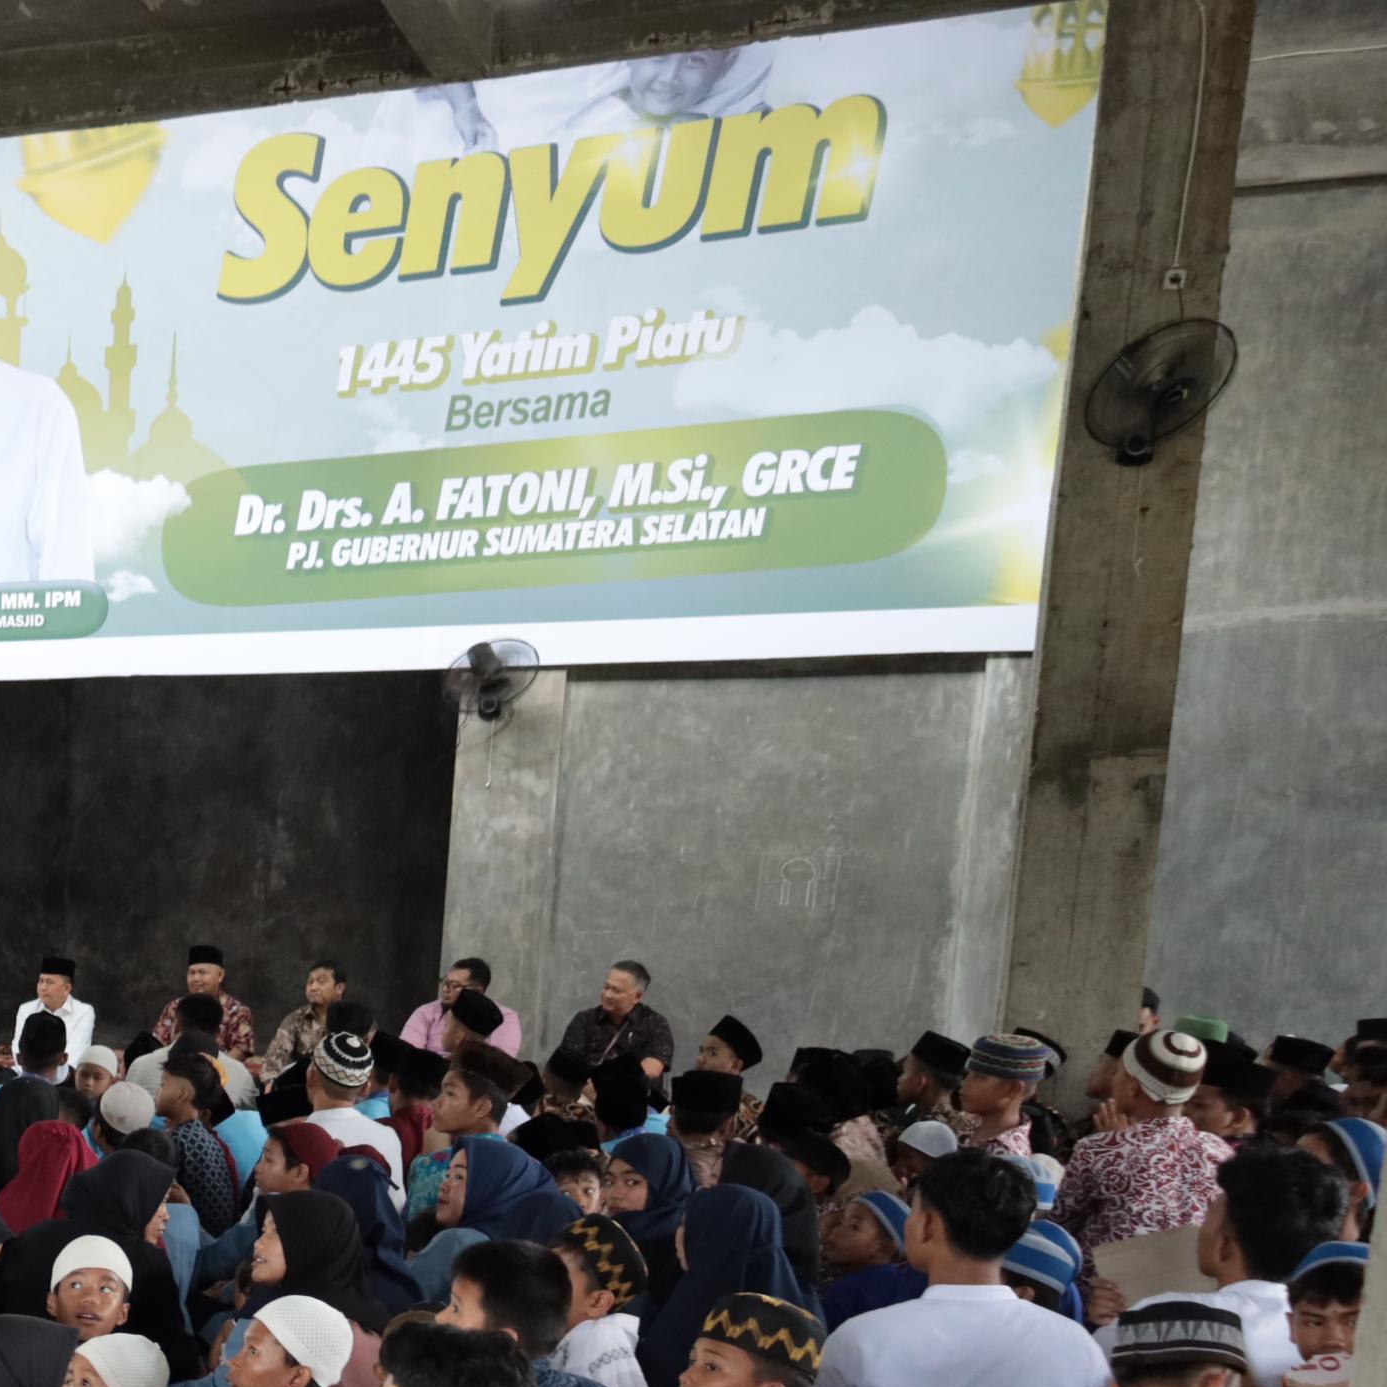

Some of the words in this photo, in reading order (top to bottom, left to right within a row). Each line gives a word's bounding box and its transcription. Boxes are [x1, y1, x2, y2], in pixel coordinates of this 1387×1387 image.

[216, 95, 888, 307] Senyum
[337, 335, 452, 397] 1445
[461, 320, 598, 385] Yatim
[602, 308, 744, 371] Piatu
[444, 388, 611, 432] Bersama
[234, 494, 286, 536] Dr.
[296, 489, 372, 532] Drs.
[380, 482, 425, 526] A.
[435, 467, 597, 521] FATONI,
[608, 453, 728, 510] M.Si.,
[742, 444, 862, 497] GRCE
[286, 540, 324, 570] PJ.
[331, 529, 480, 568] GUBERNUR
[483, 518, 634, 557] SUMATERA
[639, 507, 767, 546] SELATAN
[1, 592, 40, 611] MM.
[45, 590, 82, 608] IPM
